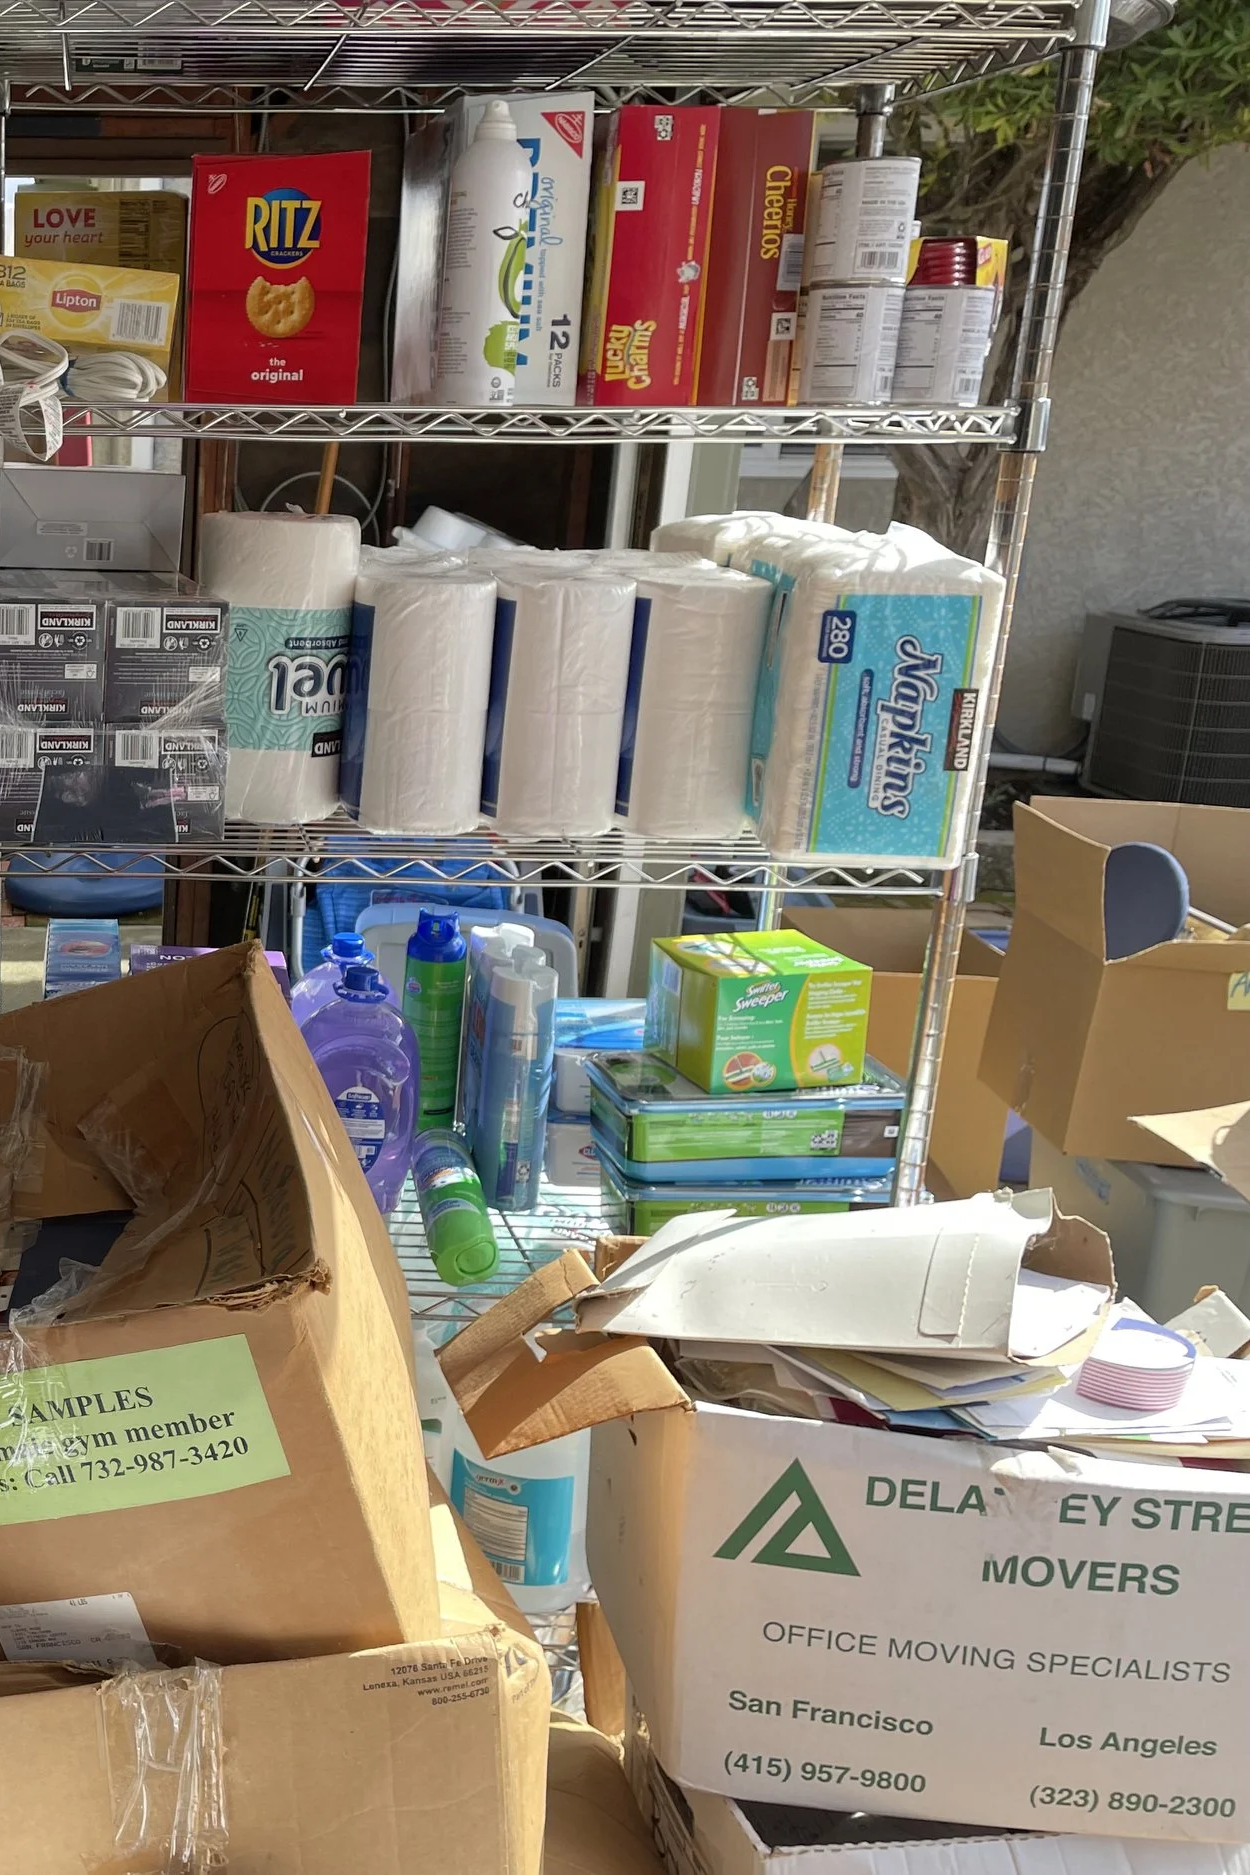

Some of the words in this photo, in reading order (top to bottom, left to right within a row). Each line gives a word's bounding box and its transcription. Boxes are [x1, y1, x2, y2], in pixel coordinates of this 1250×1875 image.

[33, 208, 96, 229] LOVE
[245, 197, 323, 251] RITZ
[541, 177, 563, 245] original
[761, 165, 792, 260] Cheerios
[25, 233, 59, 248] your
[63, 231, 103, 244] heart
[6, 280, 26, 288] BAGS
[56, 293, 97, 308] Lipton
[550, 314, 571, 350] 12
[269, 357, 286, 367] the
[552, 352, 563, 388] PACKS
[605, 324, 634, 381] Lucky
[627, 320, 657, 390] Charms
[250, 369, 303, 383] original
[42, 618, 91, 626] KIRKLAND
[167, 620, 215, 629] KIRKLAND
[828, 616, 853, 659] 280
[289, 638, 337, 649] Absorbent
[18, 704, 65, 712] KIRKLAND
[41, 740, 89, 750] KIRKLAND
[877, 636, 943, 820] Napkins
[878, 718, 890, 762] CASUAL
[954, 691, 978, 771] KIRKLAND
[870, 764, 882, 803] DINING
[733, 989, 789, 1013] Sweeper
[746, 981, 780, 997] Swiffer
[8, 1386, 154, 1427] SAMPLES
[63, 1431, 116, 1458] gym
[126, 1408, 236, 1442] member
[25, 1459, 77, 1490] Call
[80, 1436, 250, 1481] 732-987-3420
[866, 1476, 1122, 1527] DELAEY
[982, 1553, 1181, 1596] MOVERS
[35, 1640, 81, 1650] FRANCISCO
[762, 1620, 878, 1656] OFFICE
[888, 1637, 1016, 1671] MOVING
[1027, 1651, 1232, 1685] SPECIALISTS
[402, 1677, 438, 1687] Kansas
[440, 1672, 461, 1682] USA
[421, 1661, 447, 1672] Santa
[450, 1658, 462, 1668] Fe
[464, 1656, 488, 1666] Drive
[728, 1689, 782, 1717] San
[791, 1699, 934, 1736] Francisco
[1039, 1726, 1093, 1751] Los
[1100, 1731, 1219, 1759] Angeles
[724, 1750, 792, 1783] (415)
[800, 1761, 928, 1794] 957-9800
[1029, 1785, 1099, 1813] (323)
[1107, 1791, 1237, 1819] 890-2300
